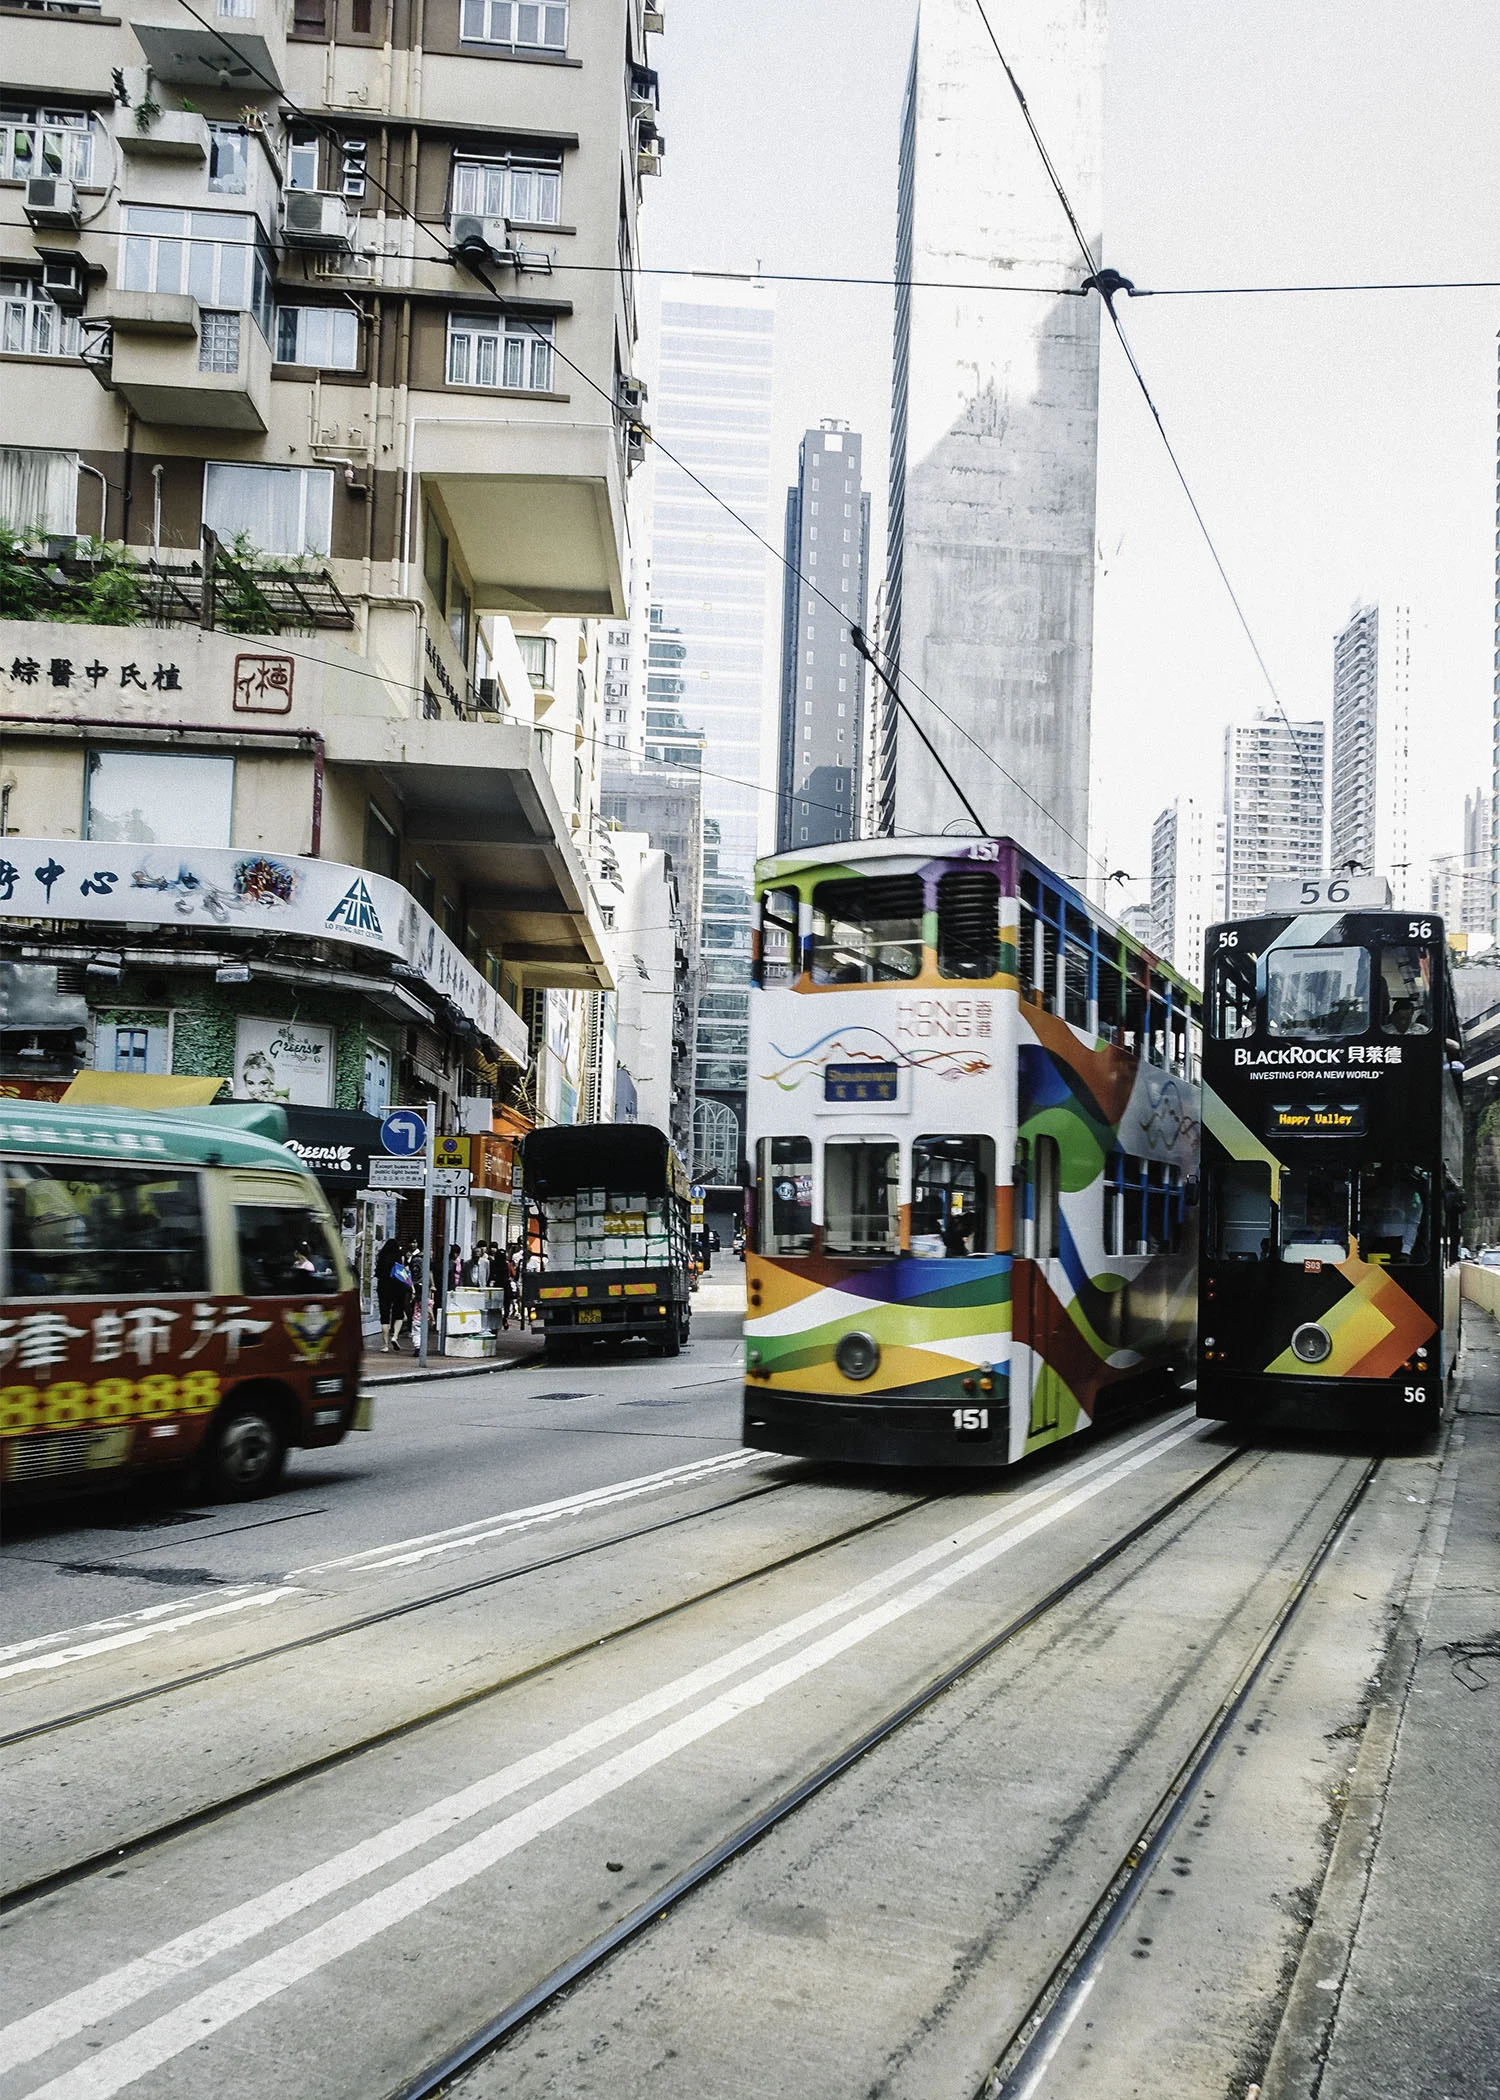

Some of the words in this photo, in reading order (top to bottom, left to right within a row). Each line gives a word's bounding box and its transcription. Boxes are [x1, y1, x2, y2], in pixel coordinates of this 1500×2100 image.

[1300, 879, 1350, 905] 56
[326, 898, 383, 934] FUNG
[1408, 921, 1433, 939] 56
[1219, 931, 1239, 948] 56
[896, 1000, 972, 1017] HONG
[896, 1020, 972, 1037] KONG
[1348, 1045, 1402, 1064] 貝萊德
[1250, 1071, 1295, 1080] INVESTING
[1296, 1071, 1314, 1079] FOR
[1315, 1071, 1323, 1079] A
[1324, 1071, 1345, 1079] NEW
[1279, 1113, 1311, 1126] Happy
[1314, 1113, 1353, 1126] Valley
[454, 1170, 462, 1180] 7
[454, 1185, 467, 1196] 12
[1304, 1260, 1321, 1270] S03
[1404, 1386, 1426, 1403] 56
[952, 1408, 989, 1430] 151
